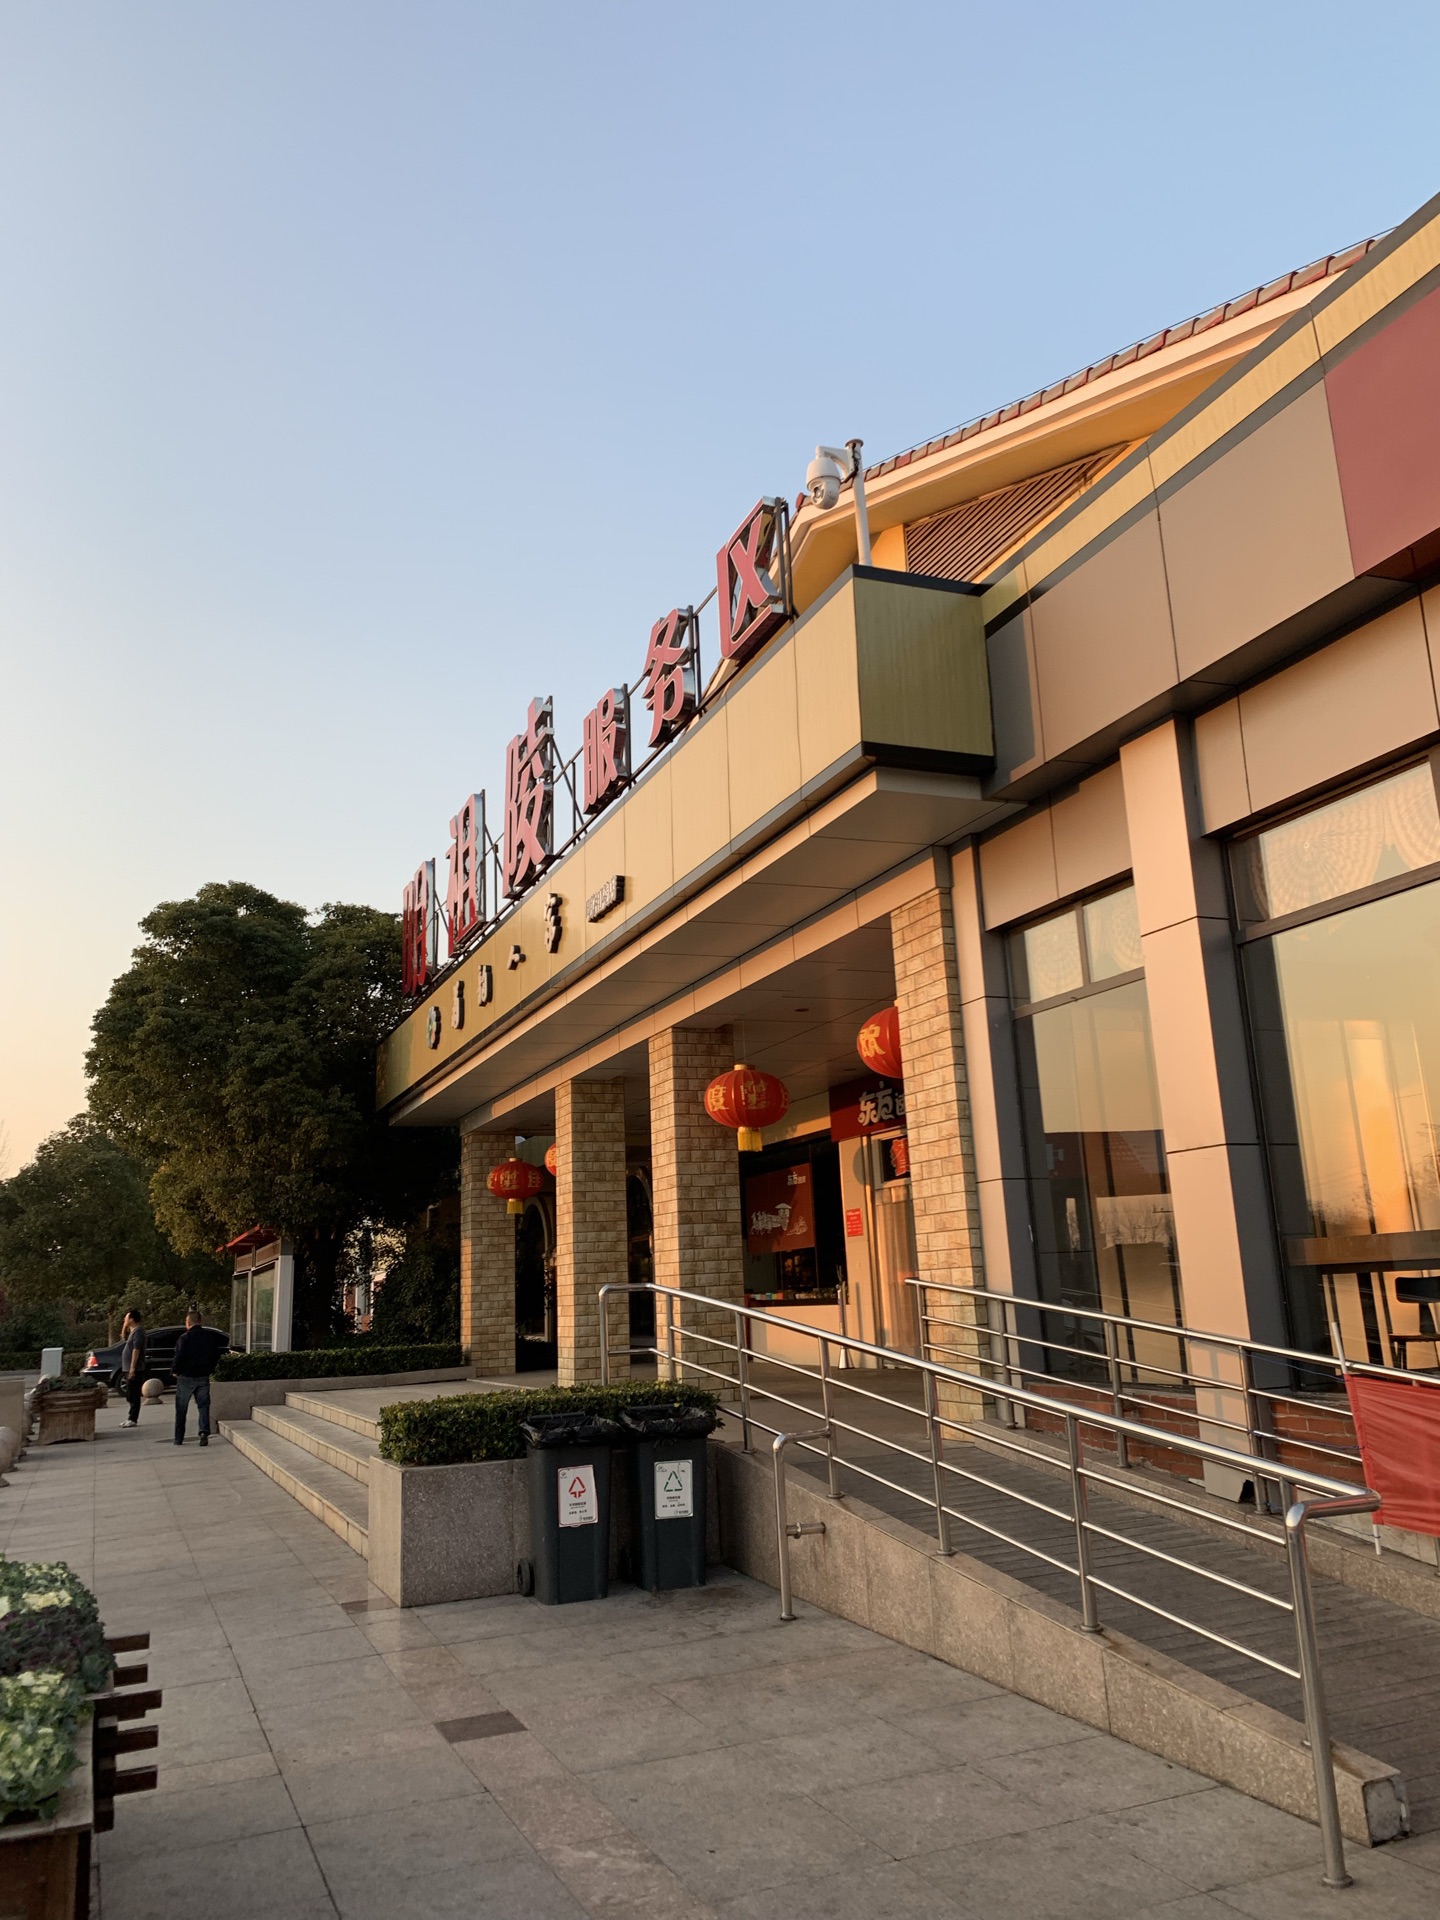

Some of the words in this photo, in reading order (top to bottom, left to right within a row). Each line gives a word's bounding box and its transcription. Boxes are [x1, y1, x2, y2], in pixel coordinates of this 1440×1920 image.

[402, 496, 786, 998] 明祖陵服务区
[707, 1085, 730, 1111] 度
